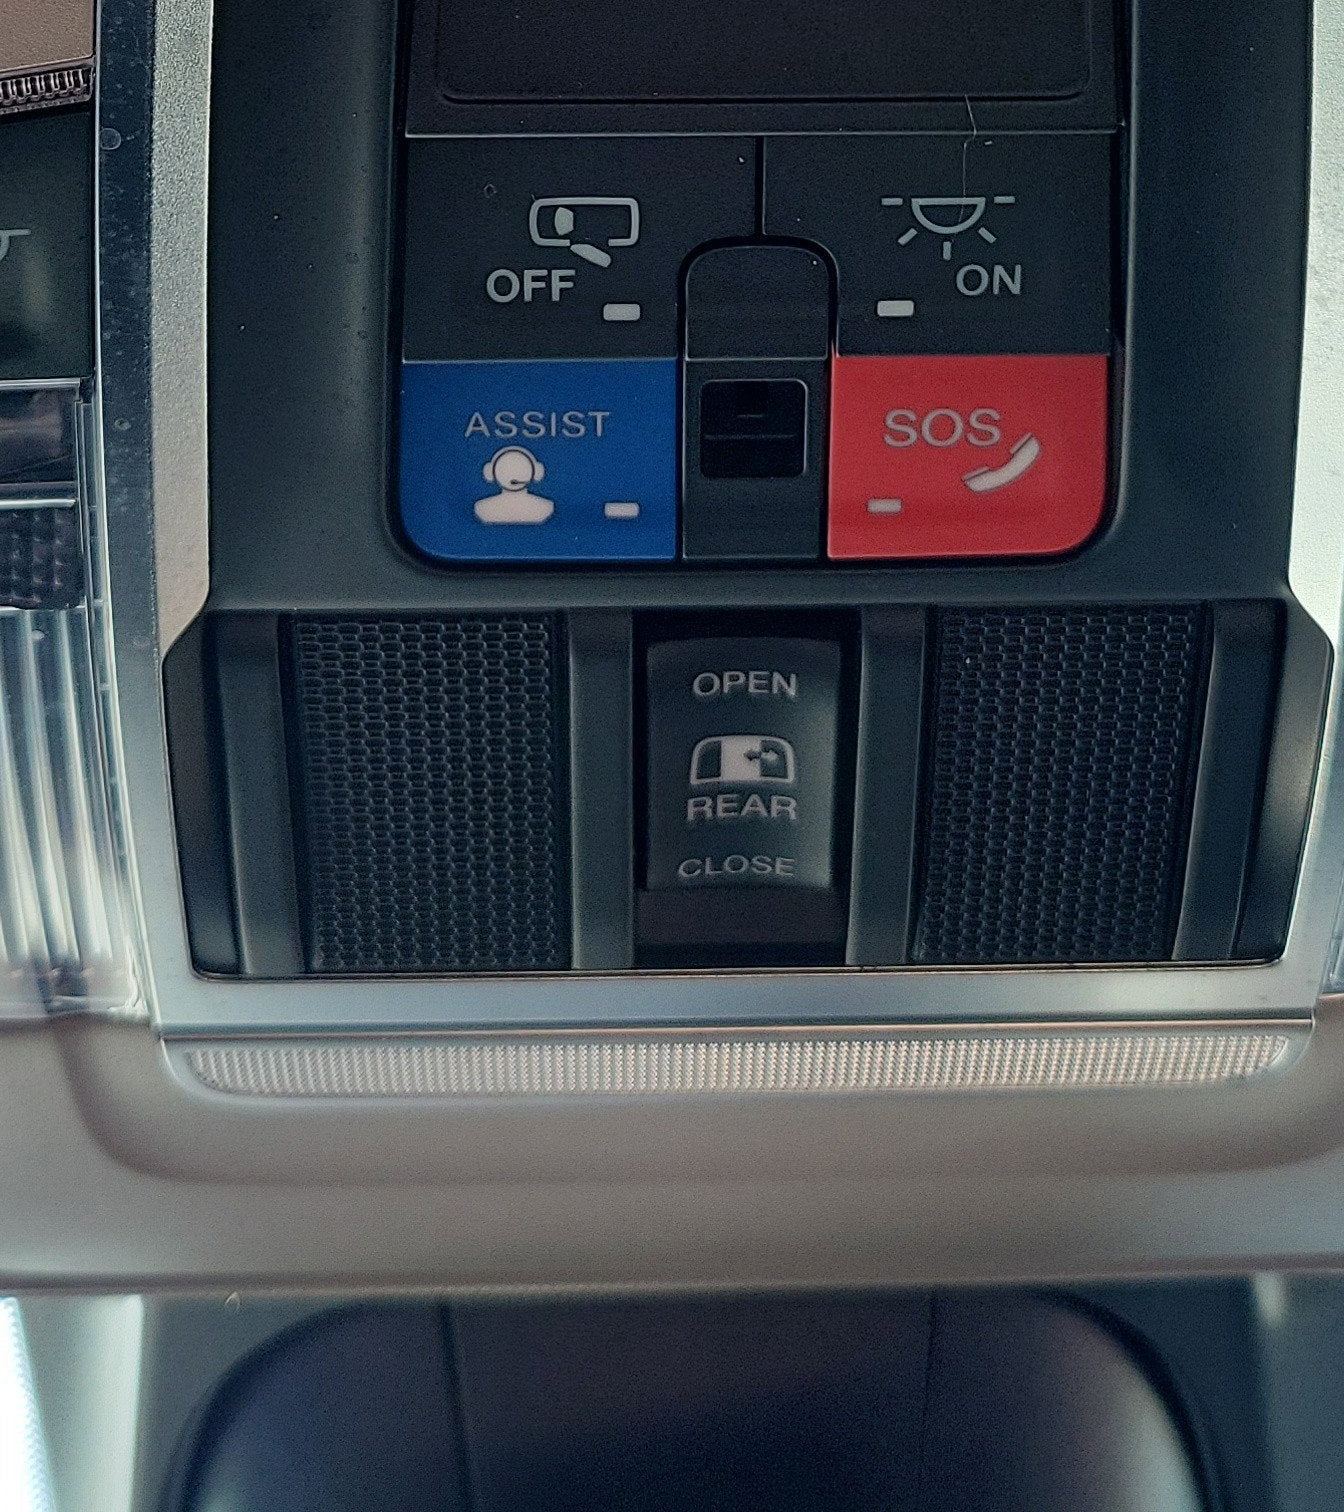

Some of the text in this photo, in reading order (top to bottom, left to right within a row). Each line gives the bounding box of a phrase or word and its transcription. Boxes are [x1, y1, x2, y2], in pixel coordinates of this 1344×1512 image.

[486, 268, 576, 303] OFF
[955, 264, 1023, 296] ON
[464, 411, 611, 439] ASSIST
[883, 408, 1002, 448] SOS
[692, 670, 798, 697] OPEN
[686, 793, 798, 821] REAR
[677, 855, 796, 878] CLOSE
